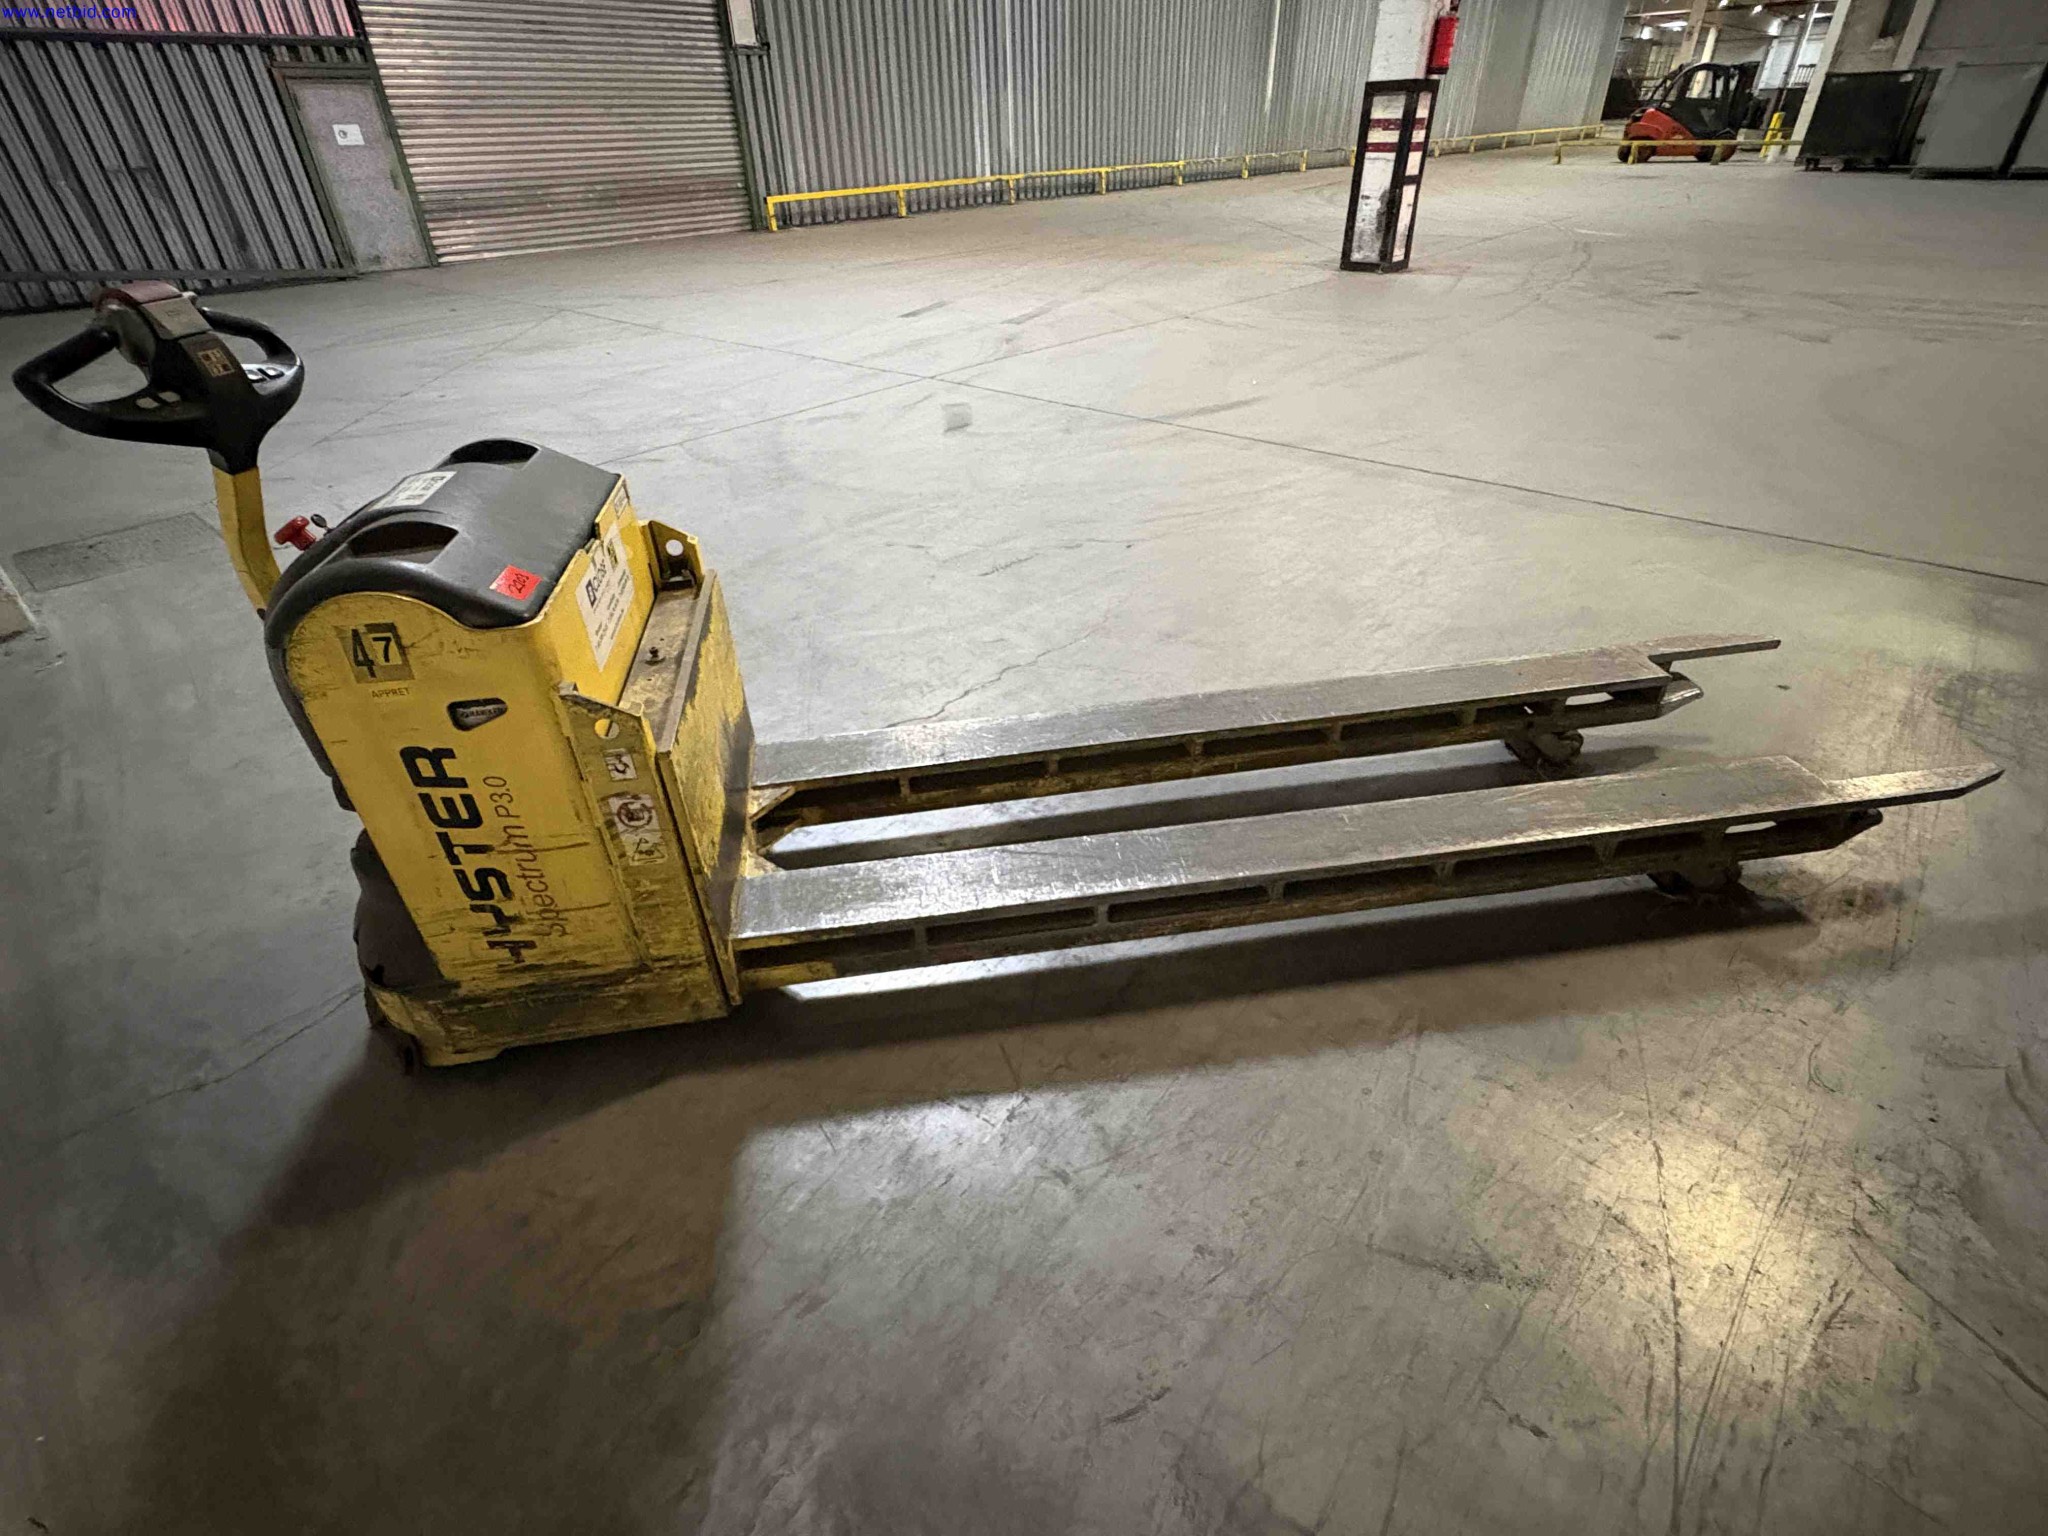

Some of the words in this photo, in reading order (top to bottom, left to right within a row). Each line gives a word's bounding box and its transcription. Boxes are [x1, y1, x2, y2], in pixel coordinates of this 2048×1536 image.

[351, 628, 394, 678] 47
[483, 775, 521, 819] P3.0
[400, 746, 538, 963] HYSTER
[503, 824, 569, 938] Spectrum
